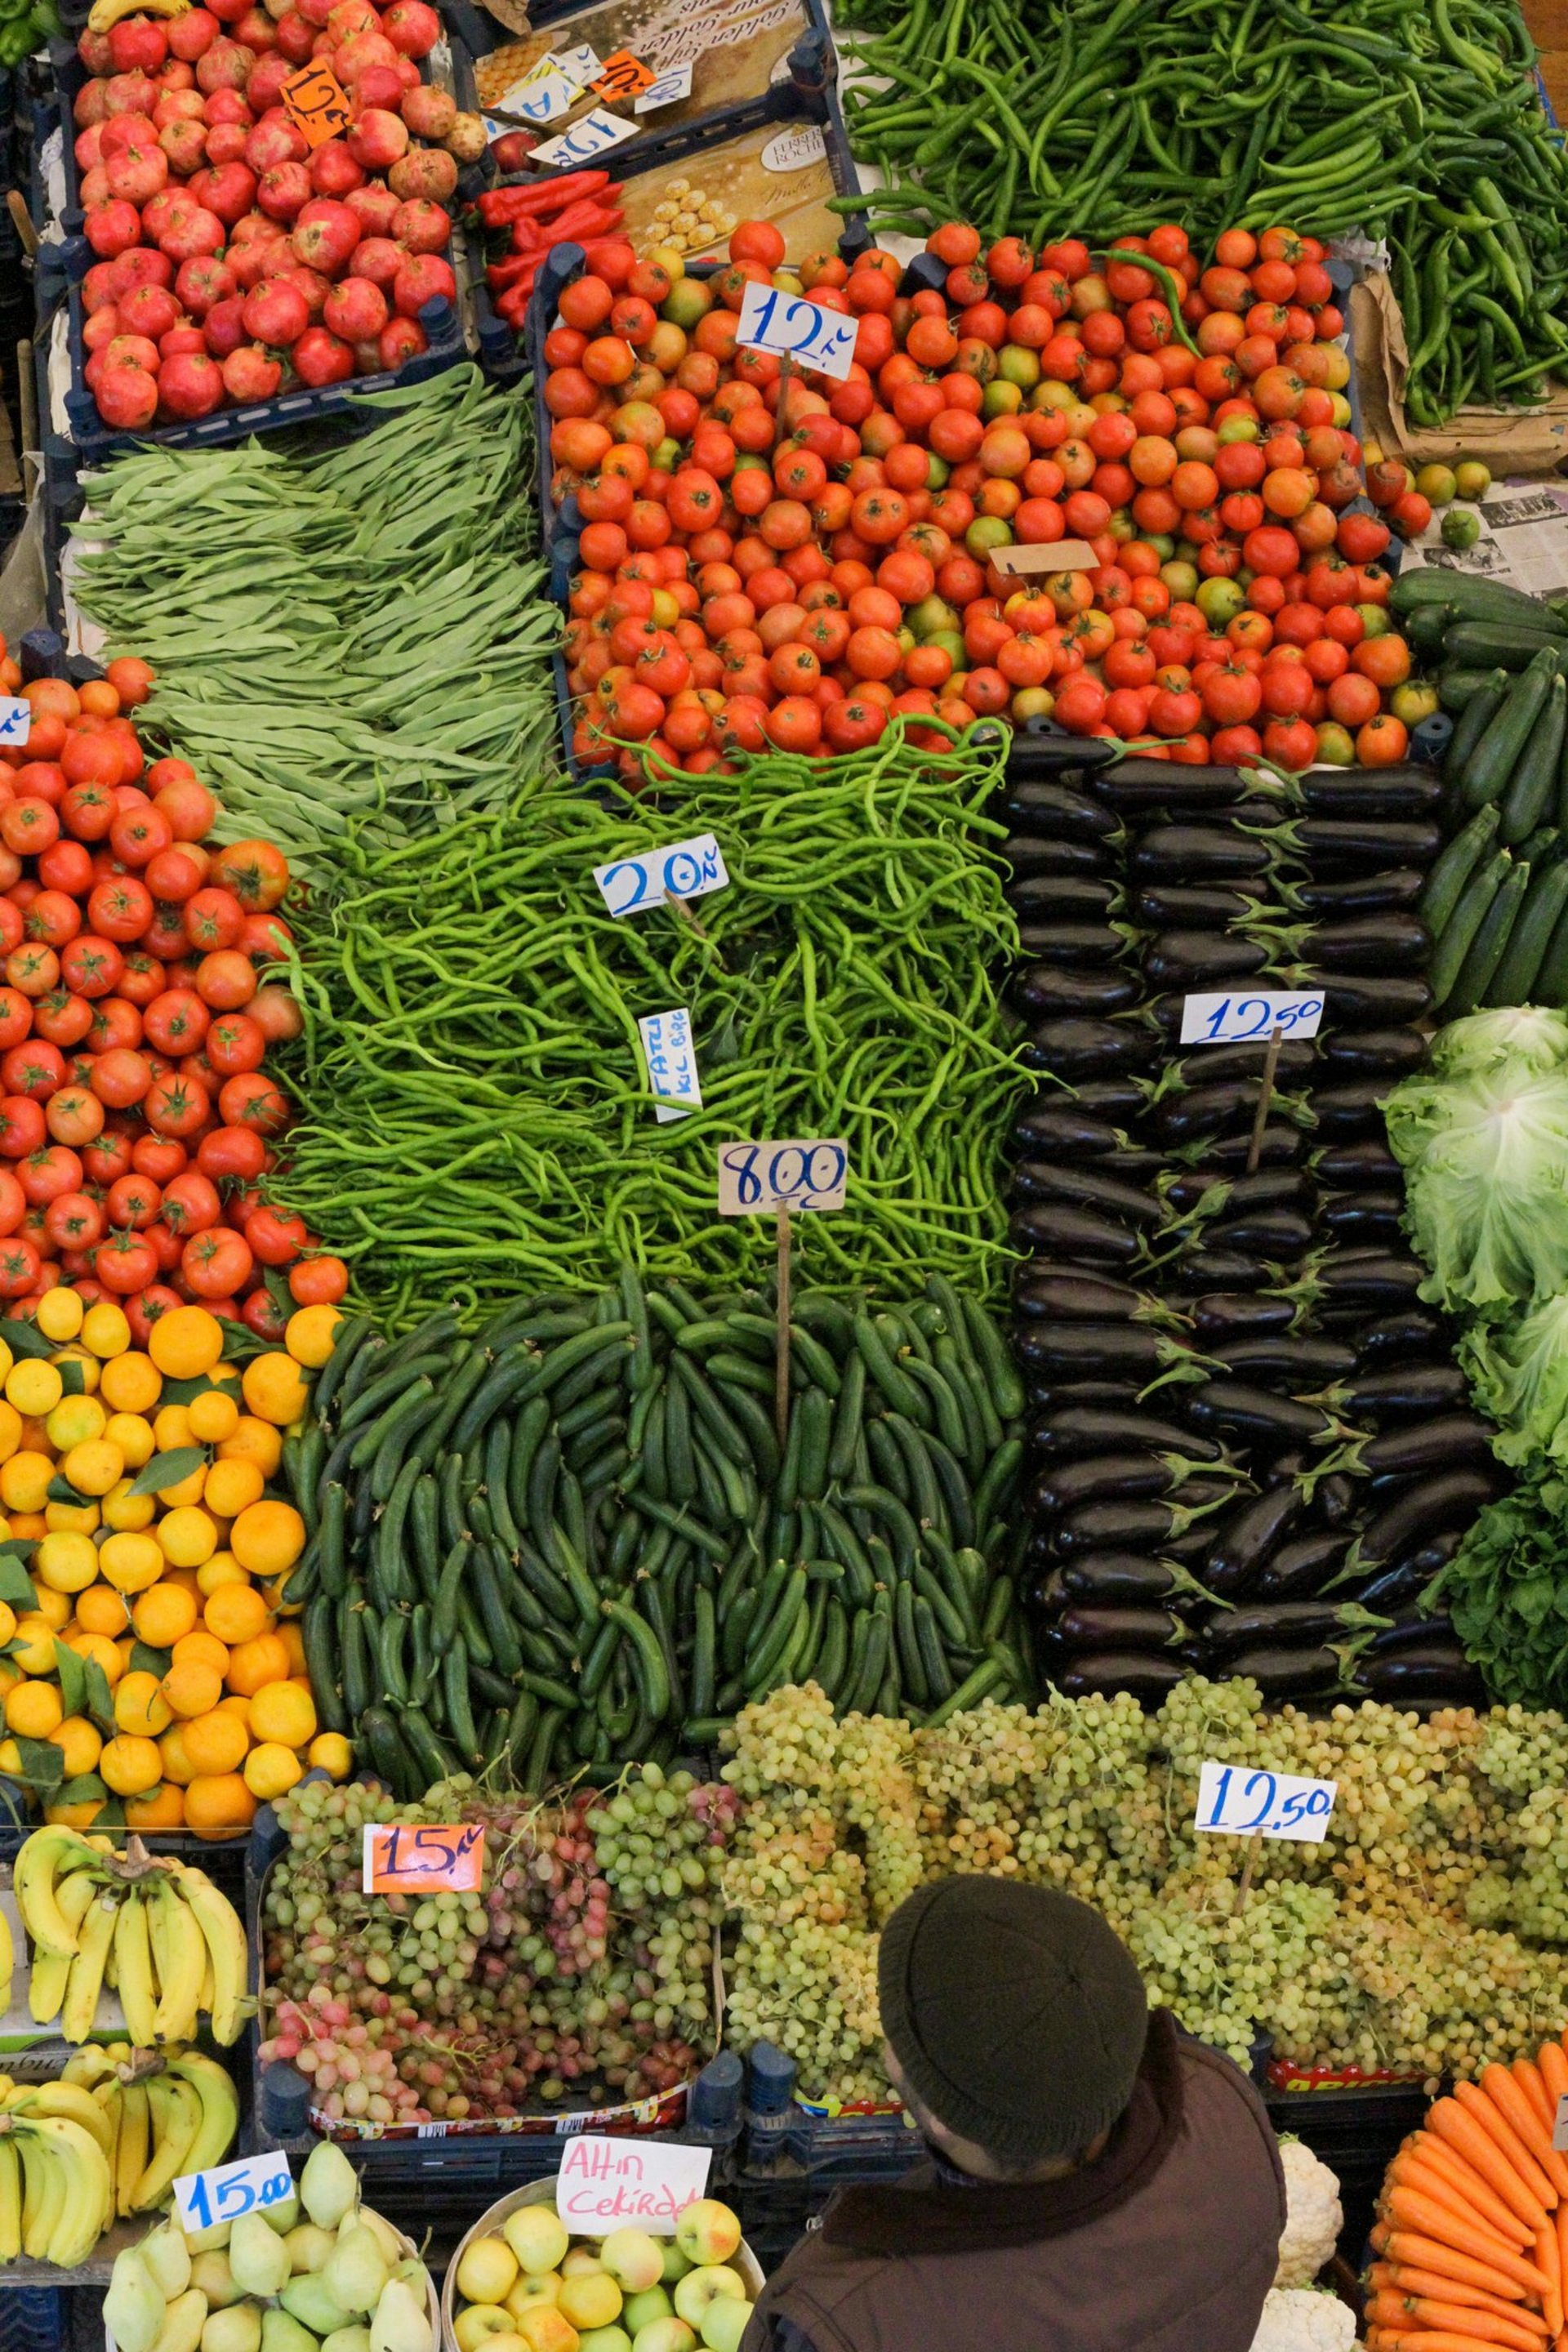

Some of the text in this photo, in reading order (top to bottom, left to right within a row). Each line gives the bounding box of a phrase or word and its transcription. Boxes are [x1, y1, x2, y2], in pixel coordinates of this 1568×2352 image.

[640, 13, 720, 52] Golden
[657, 2, 791, 71] Golden Gift
[773, 128, 822, 156] FERRER
[776, 139, 823, 165] ROCHE
